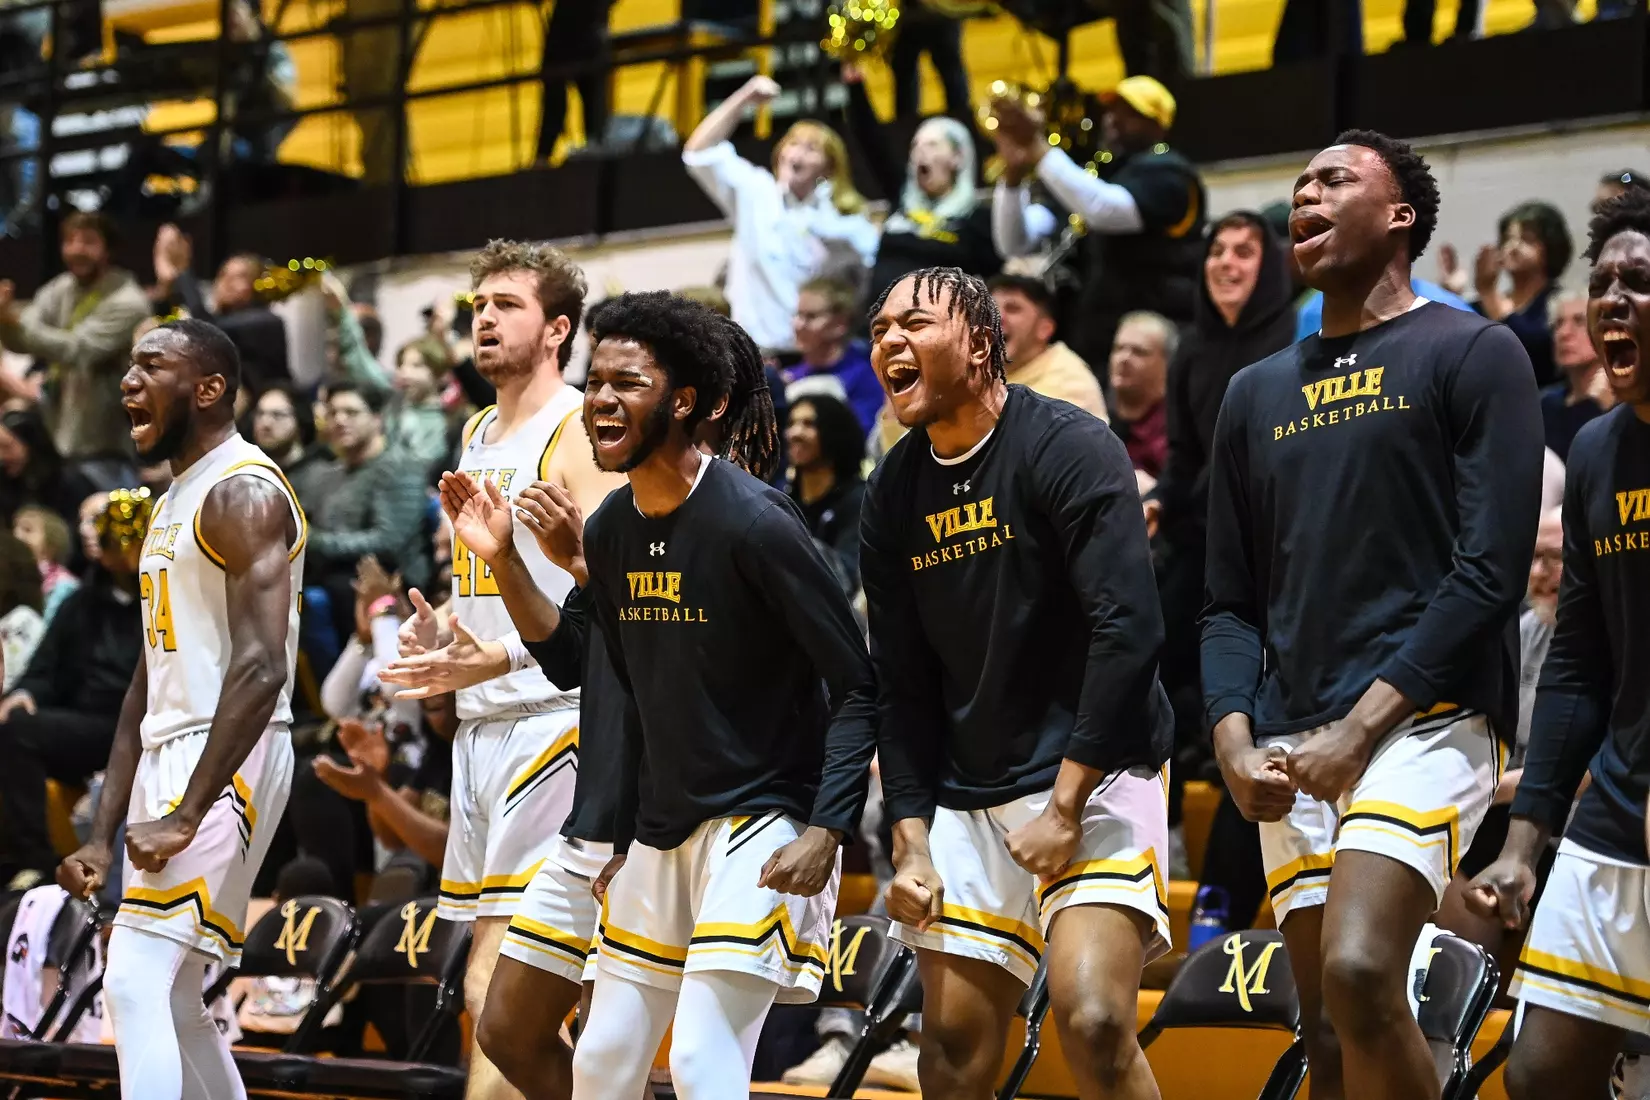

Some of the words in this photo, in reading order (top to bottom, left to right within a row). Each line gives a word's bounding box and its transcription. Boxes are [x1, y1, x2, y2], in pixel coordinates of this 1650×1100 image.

[1301, 366, 1385, 411] VILLE
[1273, 395, 1411, 441] BASKETBALL
[925, 496, 998, 543] VILLE
[139, 567, 177, 652] 34
[626, 571, 682, 604] VILLE
[618, 606, 709, 622] ASKETBALL
